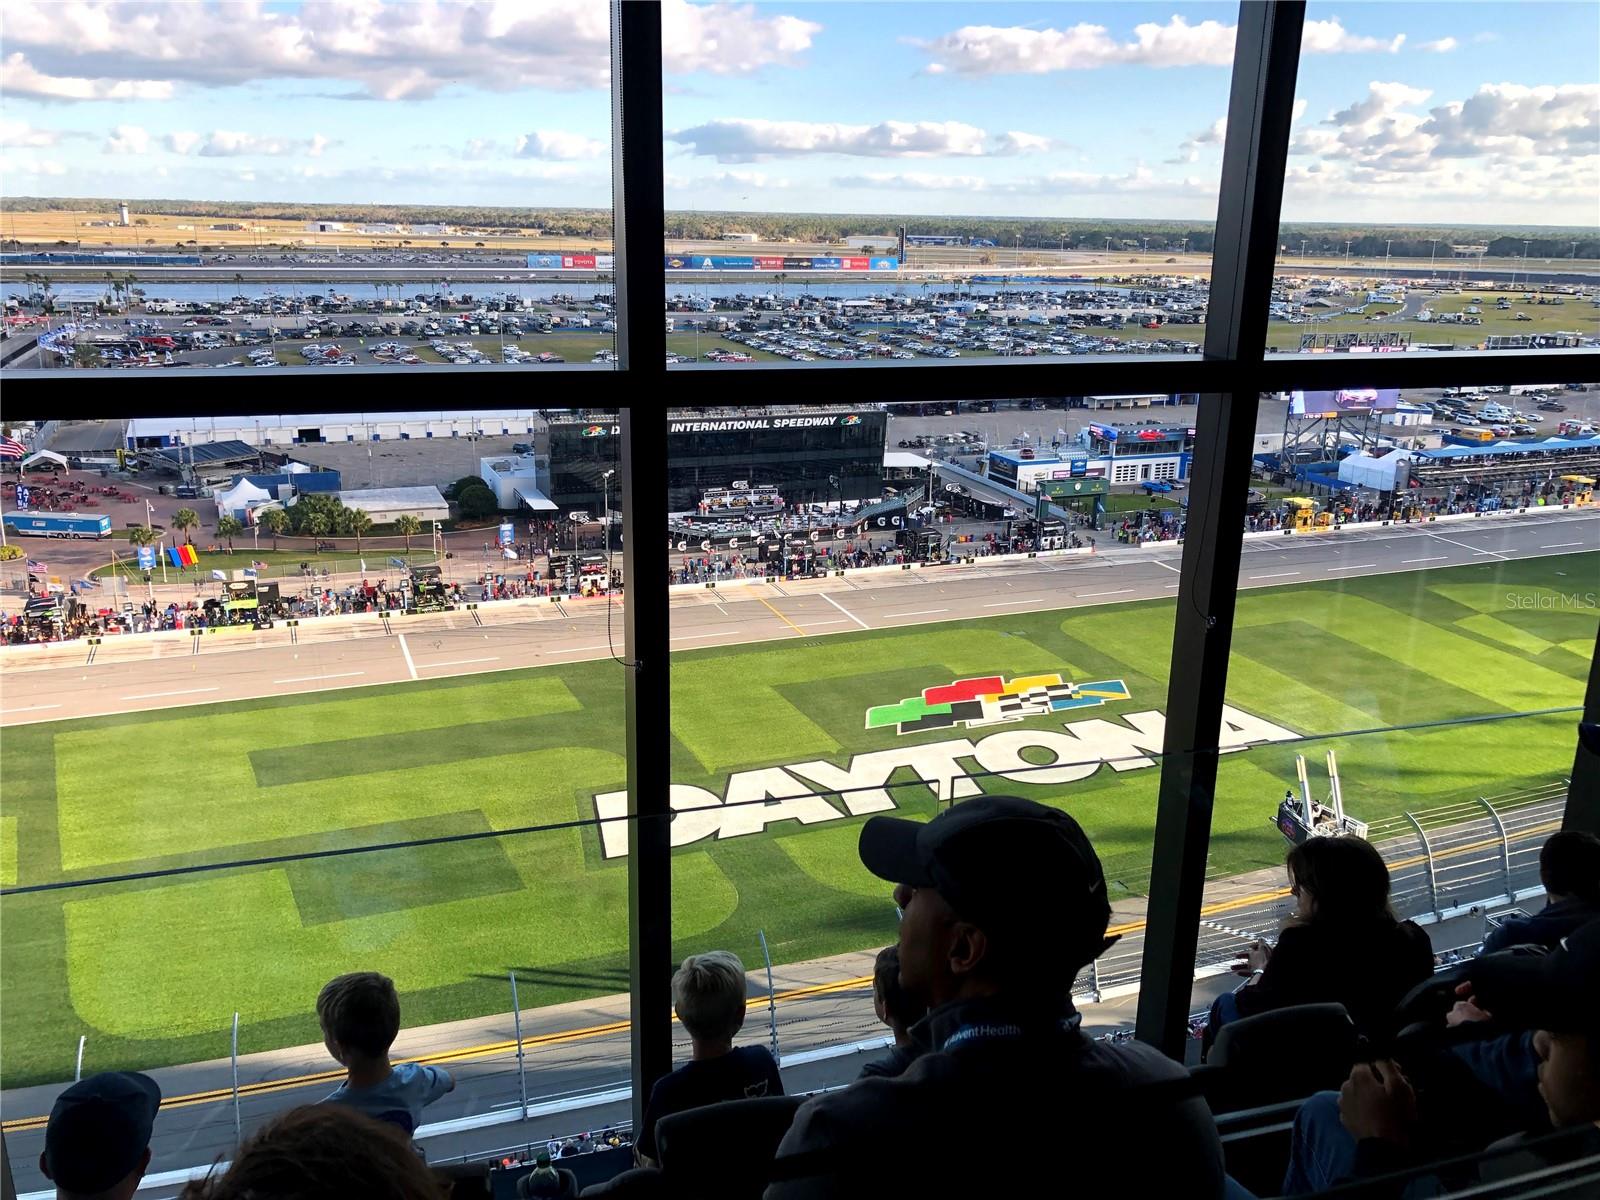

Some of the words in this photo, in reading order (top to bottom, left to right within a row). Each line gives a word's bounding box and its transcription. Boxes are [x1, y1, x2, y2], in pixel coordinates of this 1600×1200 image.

[671, 418, 770, 432] INTERNATIONAL
[773, 416, 837, 428] SPEEDWAY
[877, 517, 886, 527] G
[891, 515, 900, 526] G
[677, 540, 687, 552] G
[728, 537, 738, 548] G
[810, 530, 819, 541] G
[836, 528, 845, 539] G
[595, 702, 1305, 859] DAYTONA
